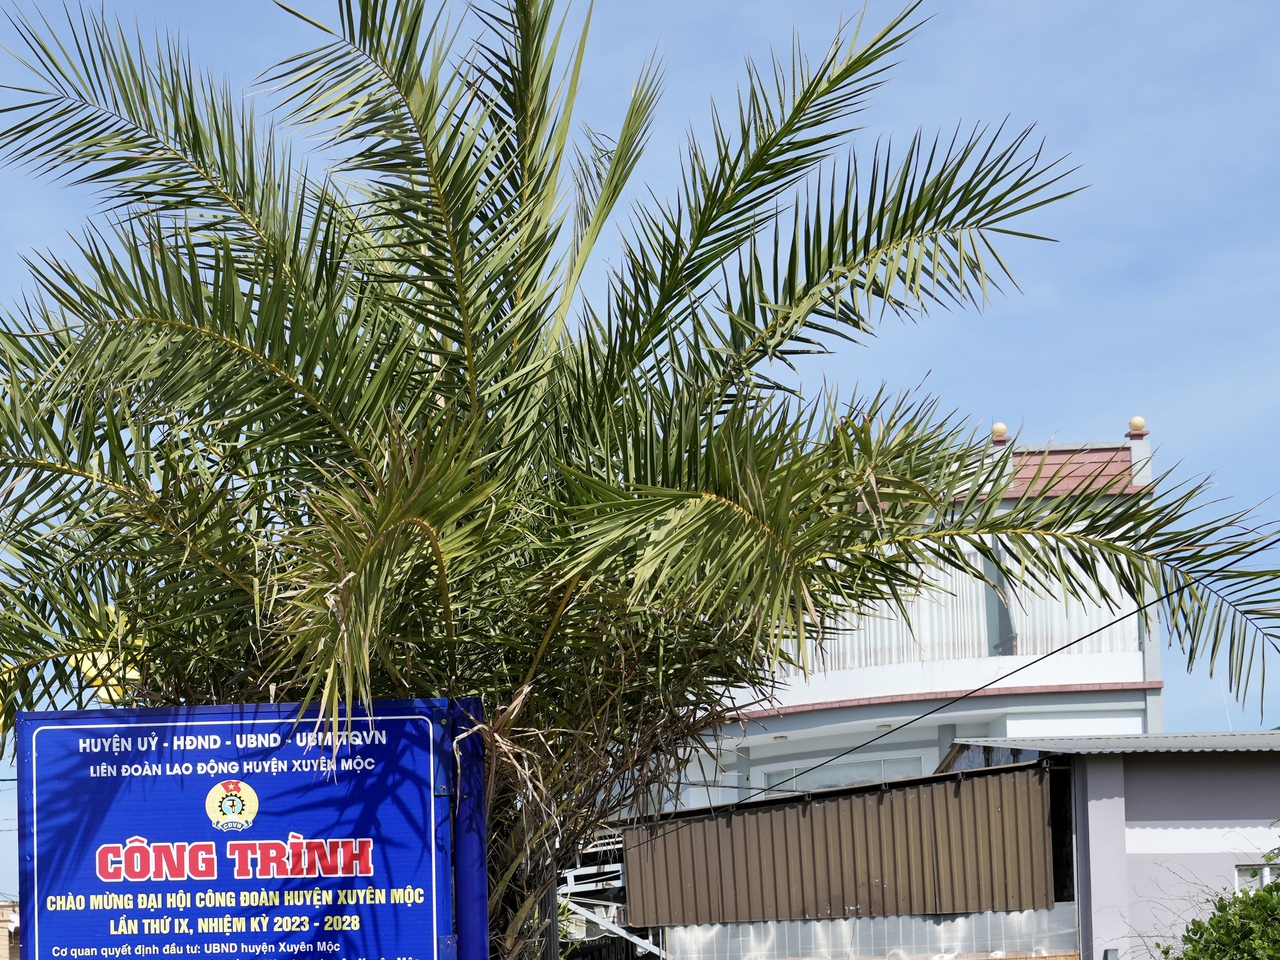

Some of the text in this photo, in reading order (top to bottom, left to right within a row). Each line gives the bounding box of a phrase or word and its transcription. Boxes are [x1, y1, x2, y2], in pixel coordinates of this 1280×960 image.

[79, 734, 131, 755] HUYỆN
[137, 732, 158, 751] UỶ
[173, 735, 220, 750] HĐND
[235, 733, 280, 748] UBND
[90, 755, 375, 777] LIÊN ĐOÀN LAO ĐỘNG HUYỆN XUYÊN MỘC
[95, 830, 373, 882] CÔNG TRÌNH
[46, 885, 423, 912] CHÀO MỪNG ĐẠI HỘI CÔNG ĐOÀN HUYỆN XUYÊN MỘC
[110, 915, 137, 935] LẦN
[141, 916, 171, 934] THỨ
[174, 918, 192, 935] IX,
[197, 914, 245, 936] NHIỆM
[250, 914, 268, 932] KỲ
[272, 916, 308, 931] 2023
[323, 915, 358, 930] 2028
[52, 941, 339, 958] Cơ quan quyết định đầu tư: UBND huyện Xuyên Mộc
